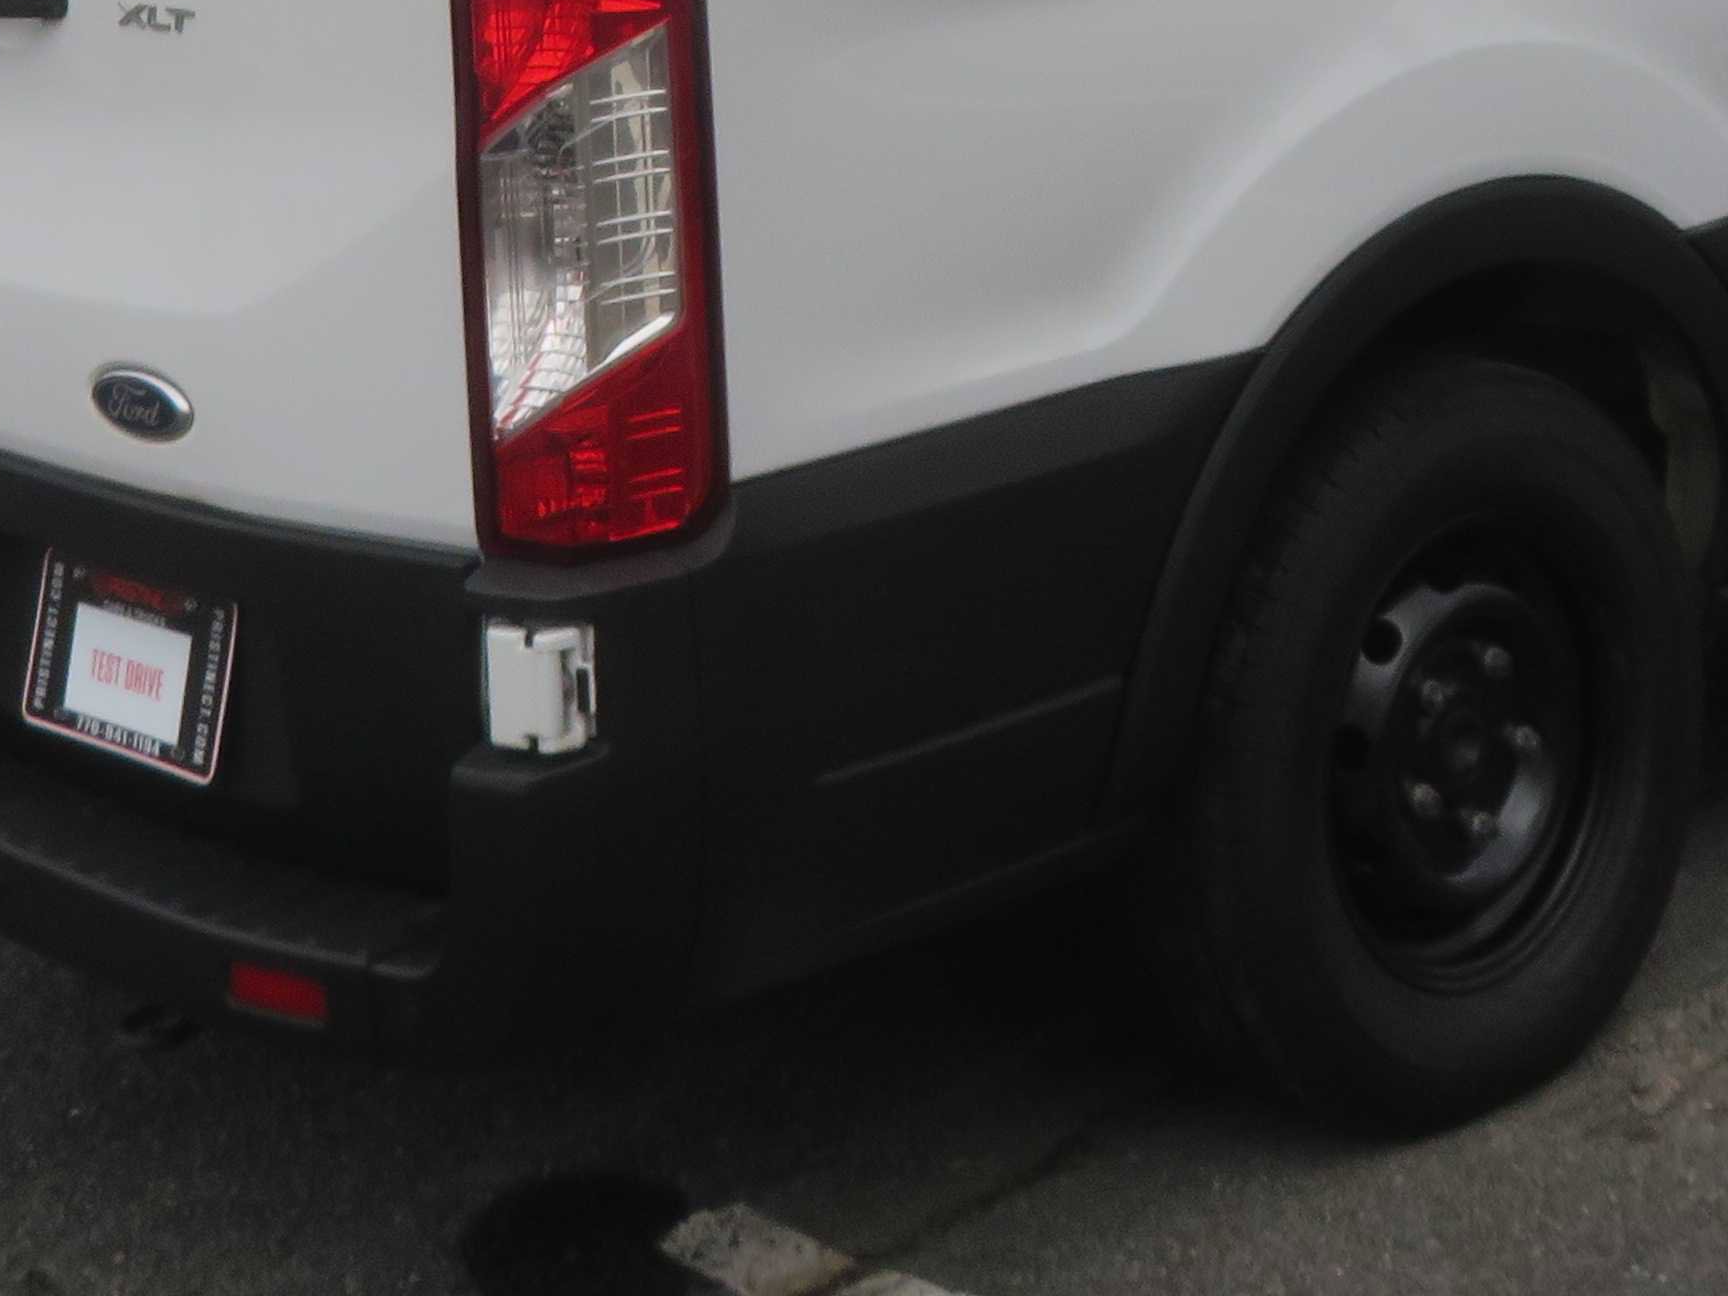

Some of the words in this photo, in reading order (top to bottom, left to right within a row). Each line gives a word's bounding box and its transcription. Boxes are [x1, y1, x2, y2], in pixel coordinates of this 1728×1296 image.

[118, 1, 196, 33] XLT
[108, 382, 160, 427] Ford
[91, 648, 122, 686] TEST
[125, 659, 165, 702] DRIVE
